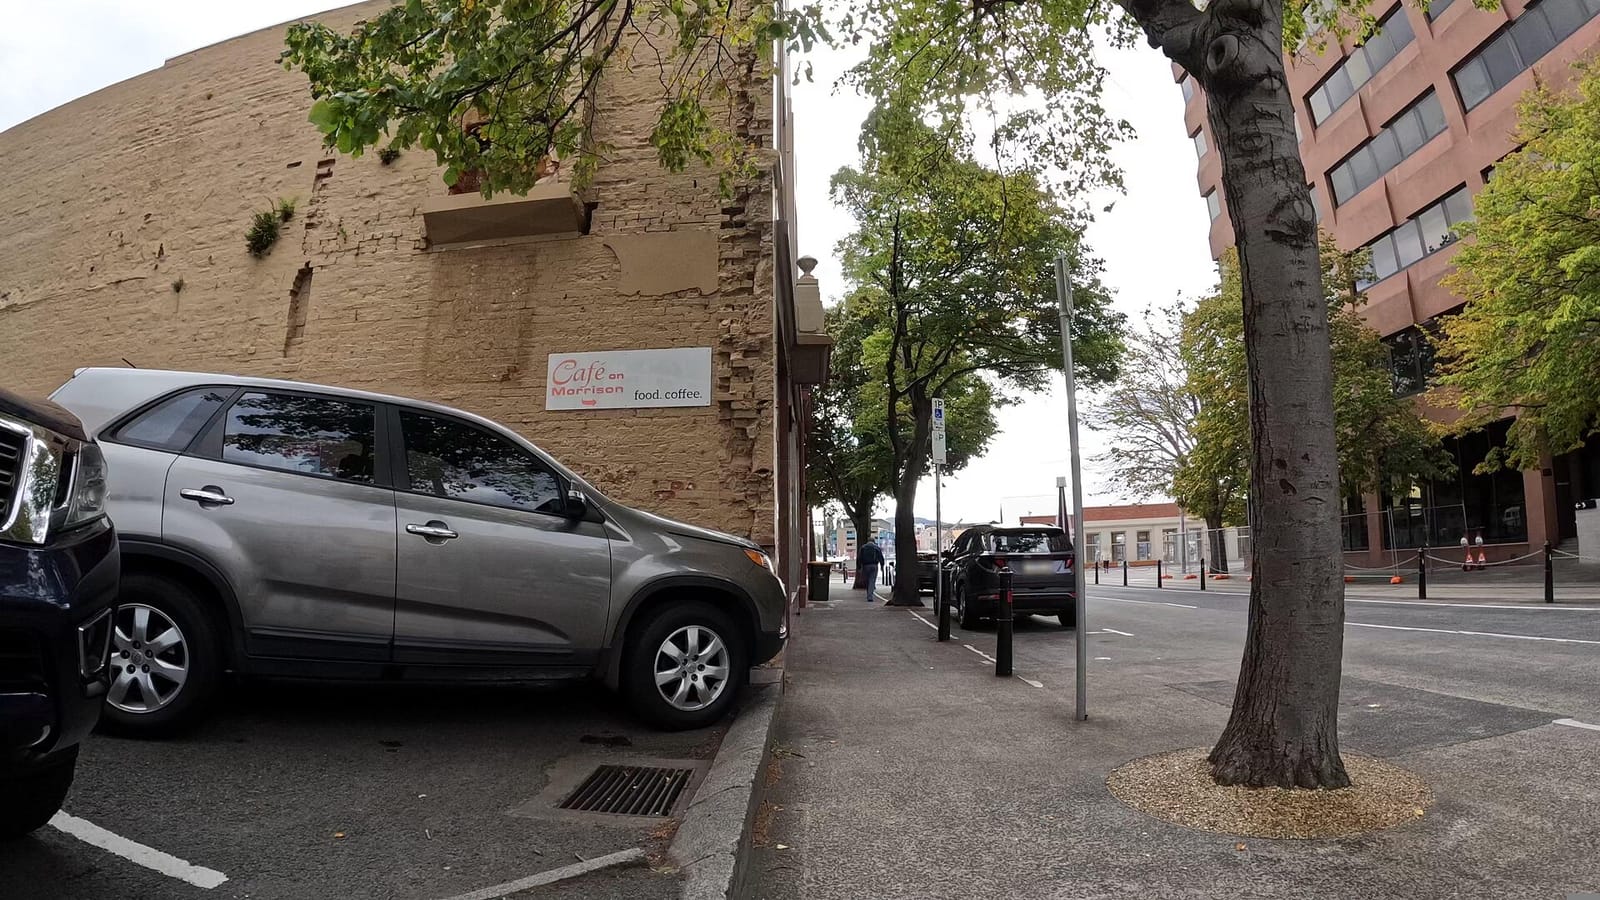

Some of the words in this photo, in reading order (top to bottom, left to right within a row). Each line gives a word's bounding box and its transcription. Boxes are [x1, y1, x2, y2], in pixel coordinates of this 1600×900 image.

[552, 359, 607, 388] Café
[552, 386, 624, 396] Morrison
[634, 389, 662, 401] food.
[664, 388, 703, 400] coffee.
